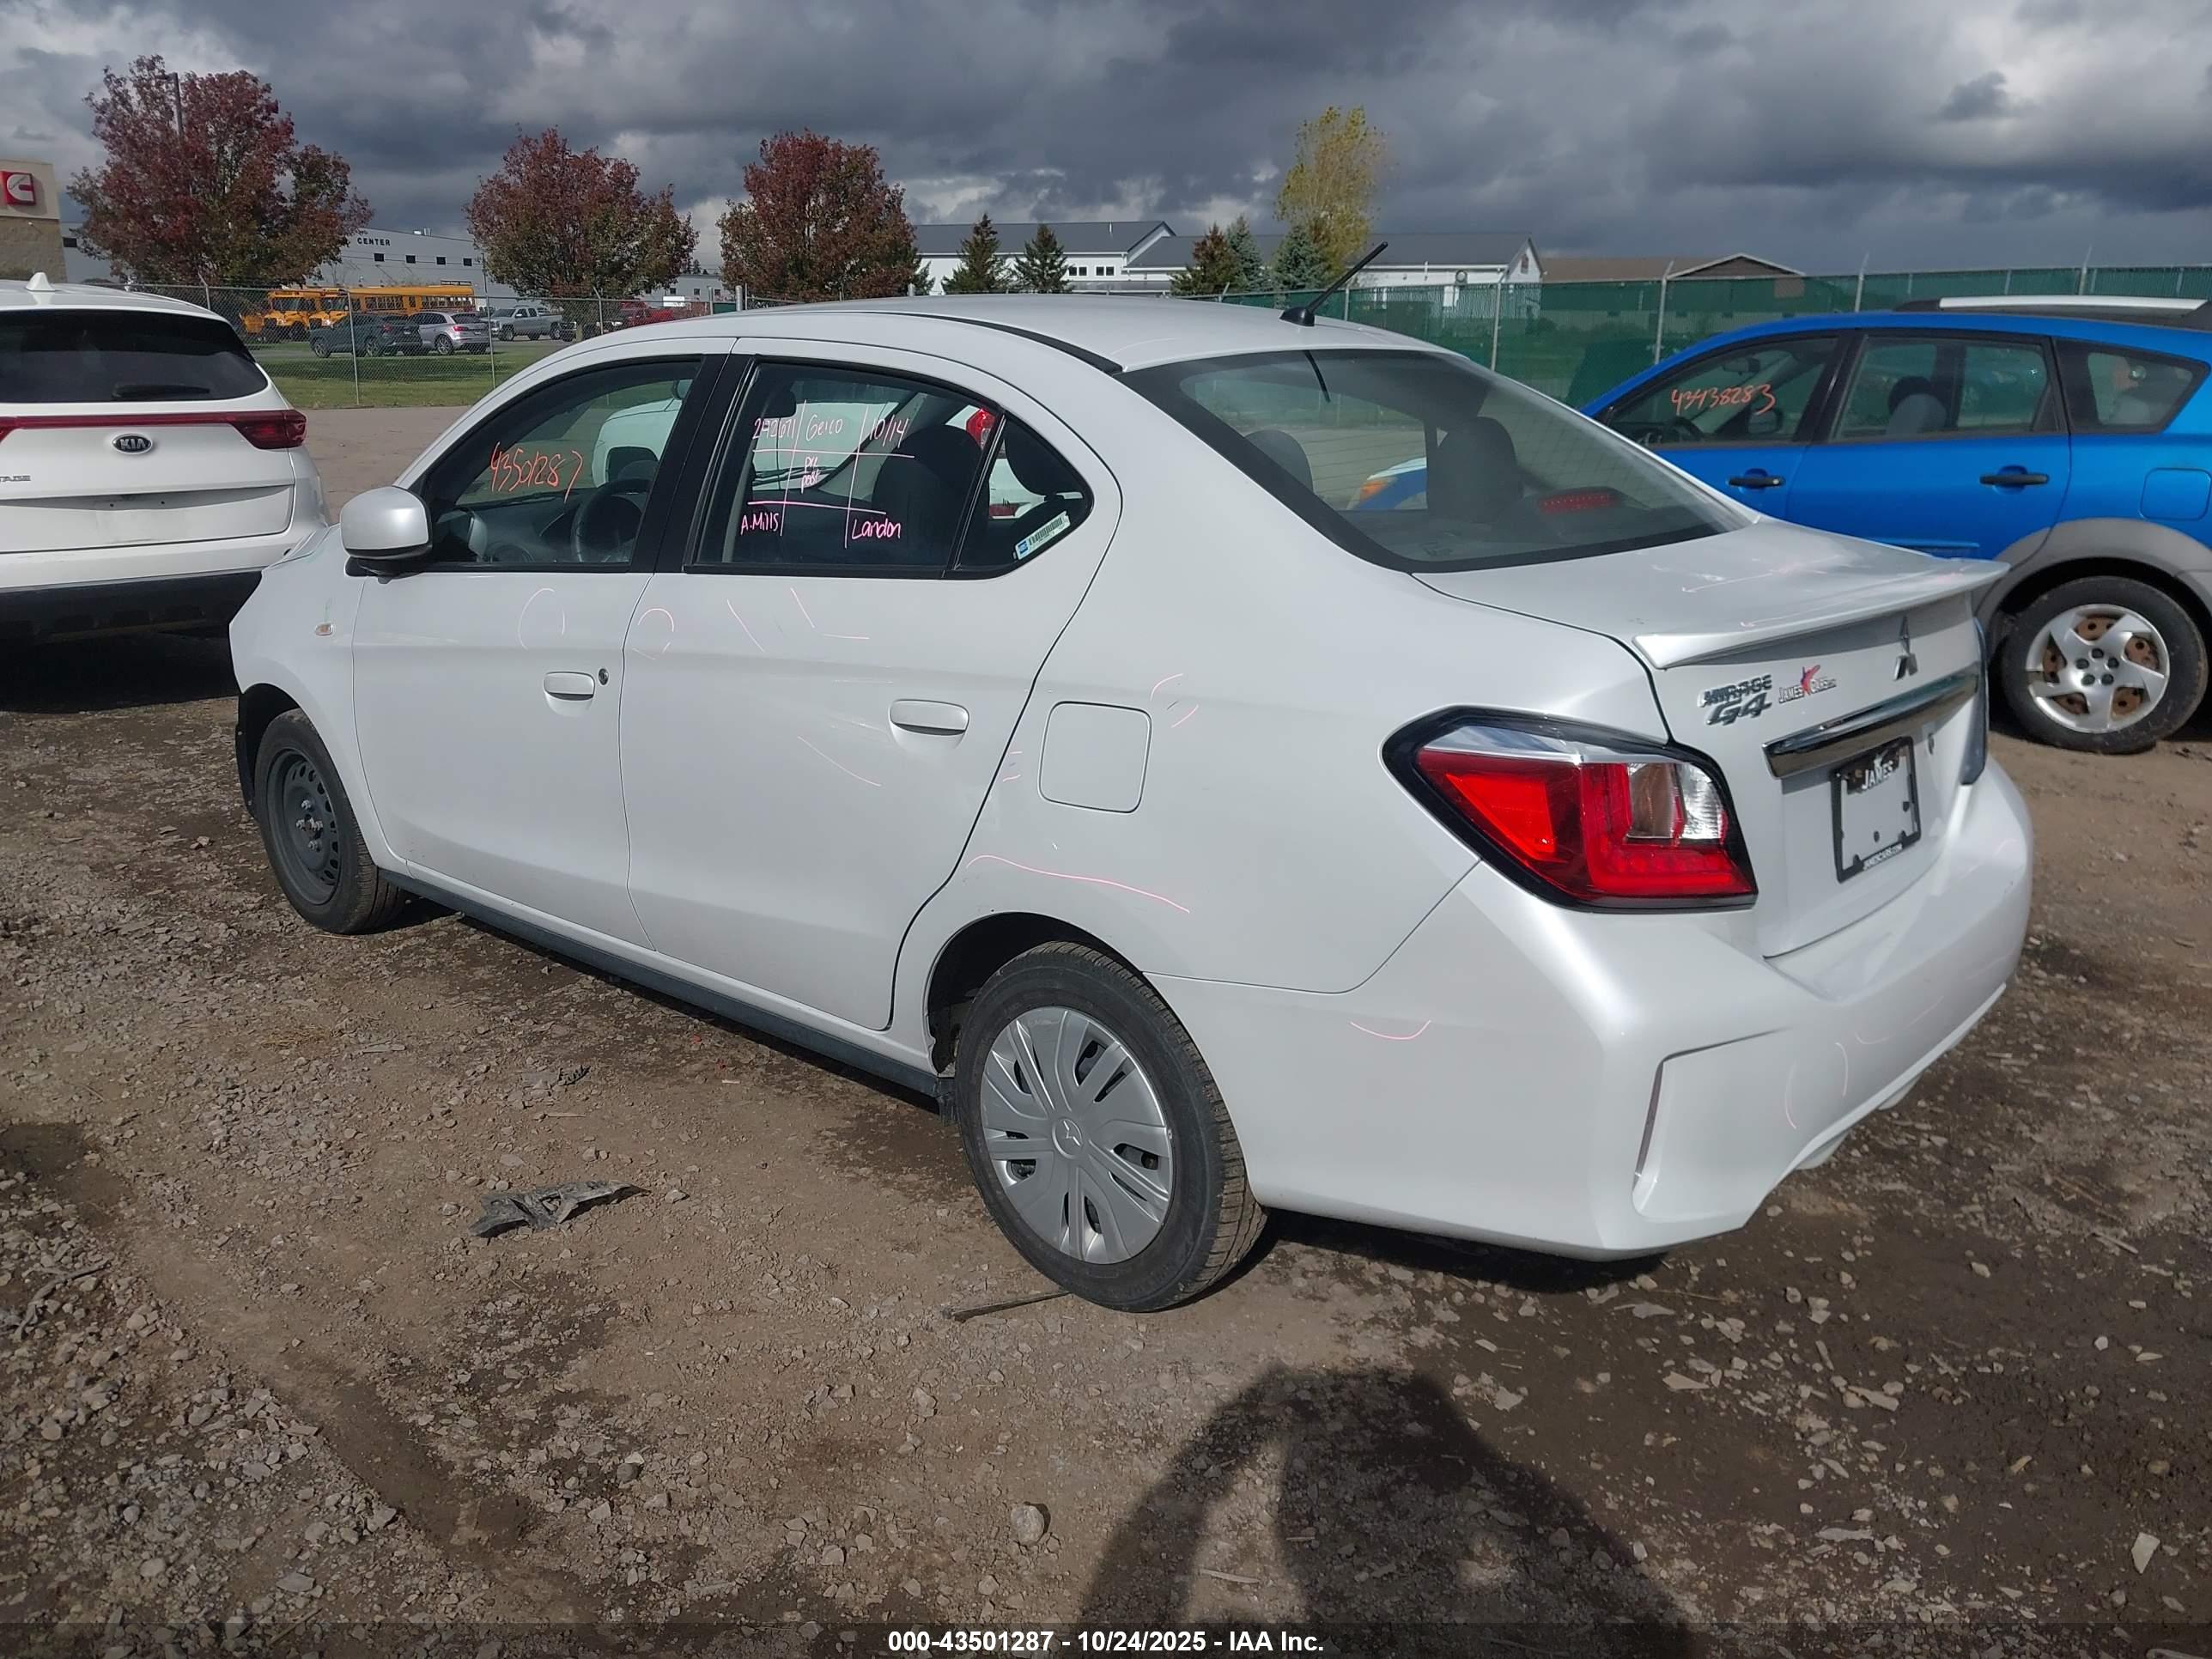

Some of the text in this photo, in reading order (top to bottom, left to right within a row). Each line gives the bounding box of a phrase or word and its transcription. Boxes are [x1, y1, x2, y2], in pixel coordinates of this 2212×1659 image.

[356, 237, 391, 246] CENTER
[119, 438, 146, 451] KIA
[869, 415, 909, 448] 10/14
[490, 440, 583, 504] 43501287
[851, 518, 902, 540] Landon
[1698, 674, 1773, 708] MIRAGE
[1705, 691, 1773, 726] G4
[1861, 759, 1894, 791] JAMES
